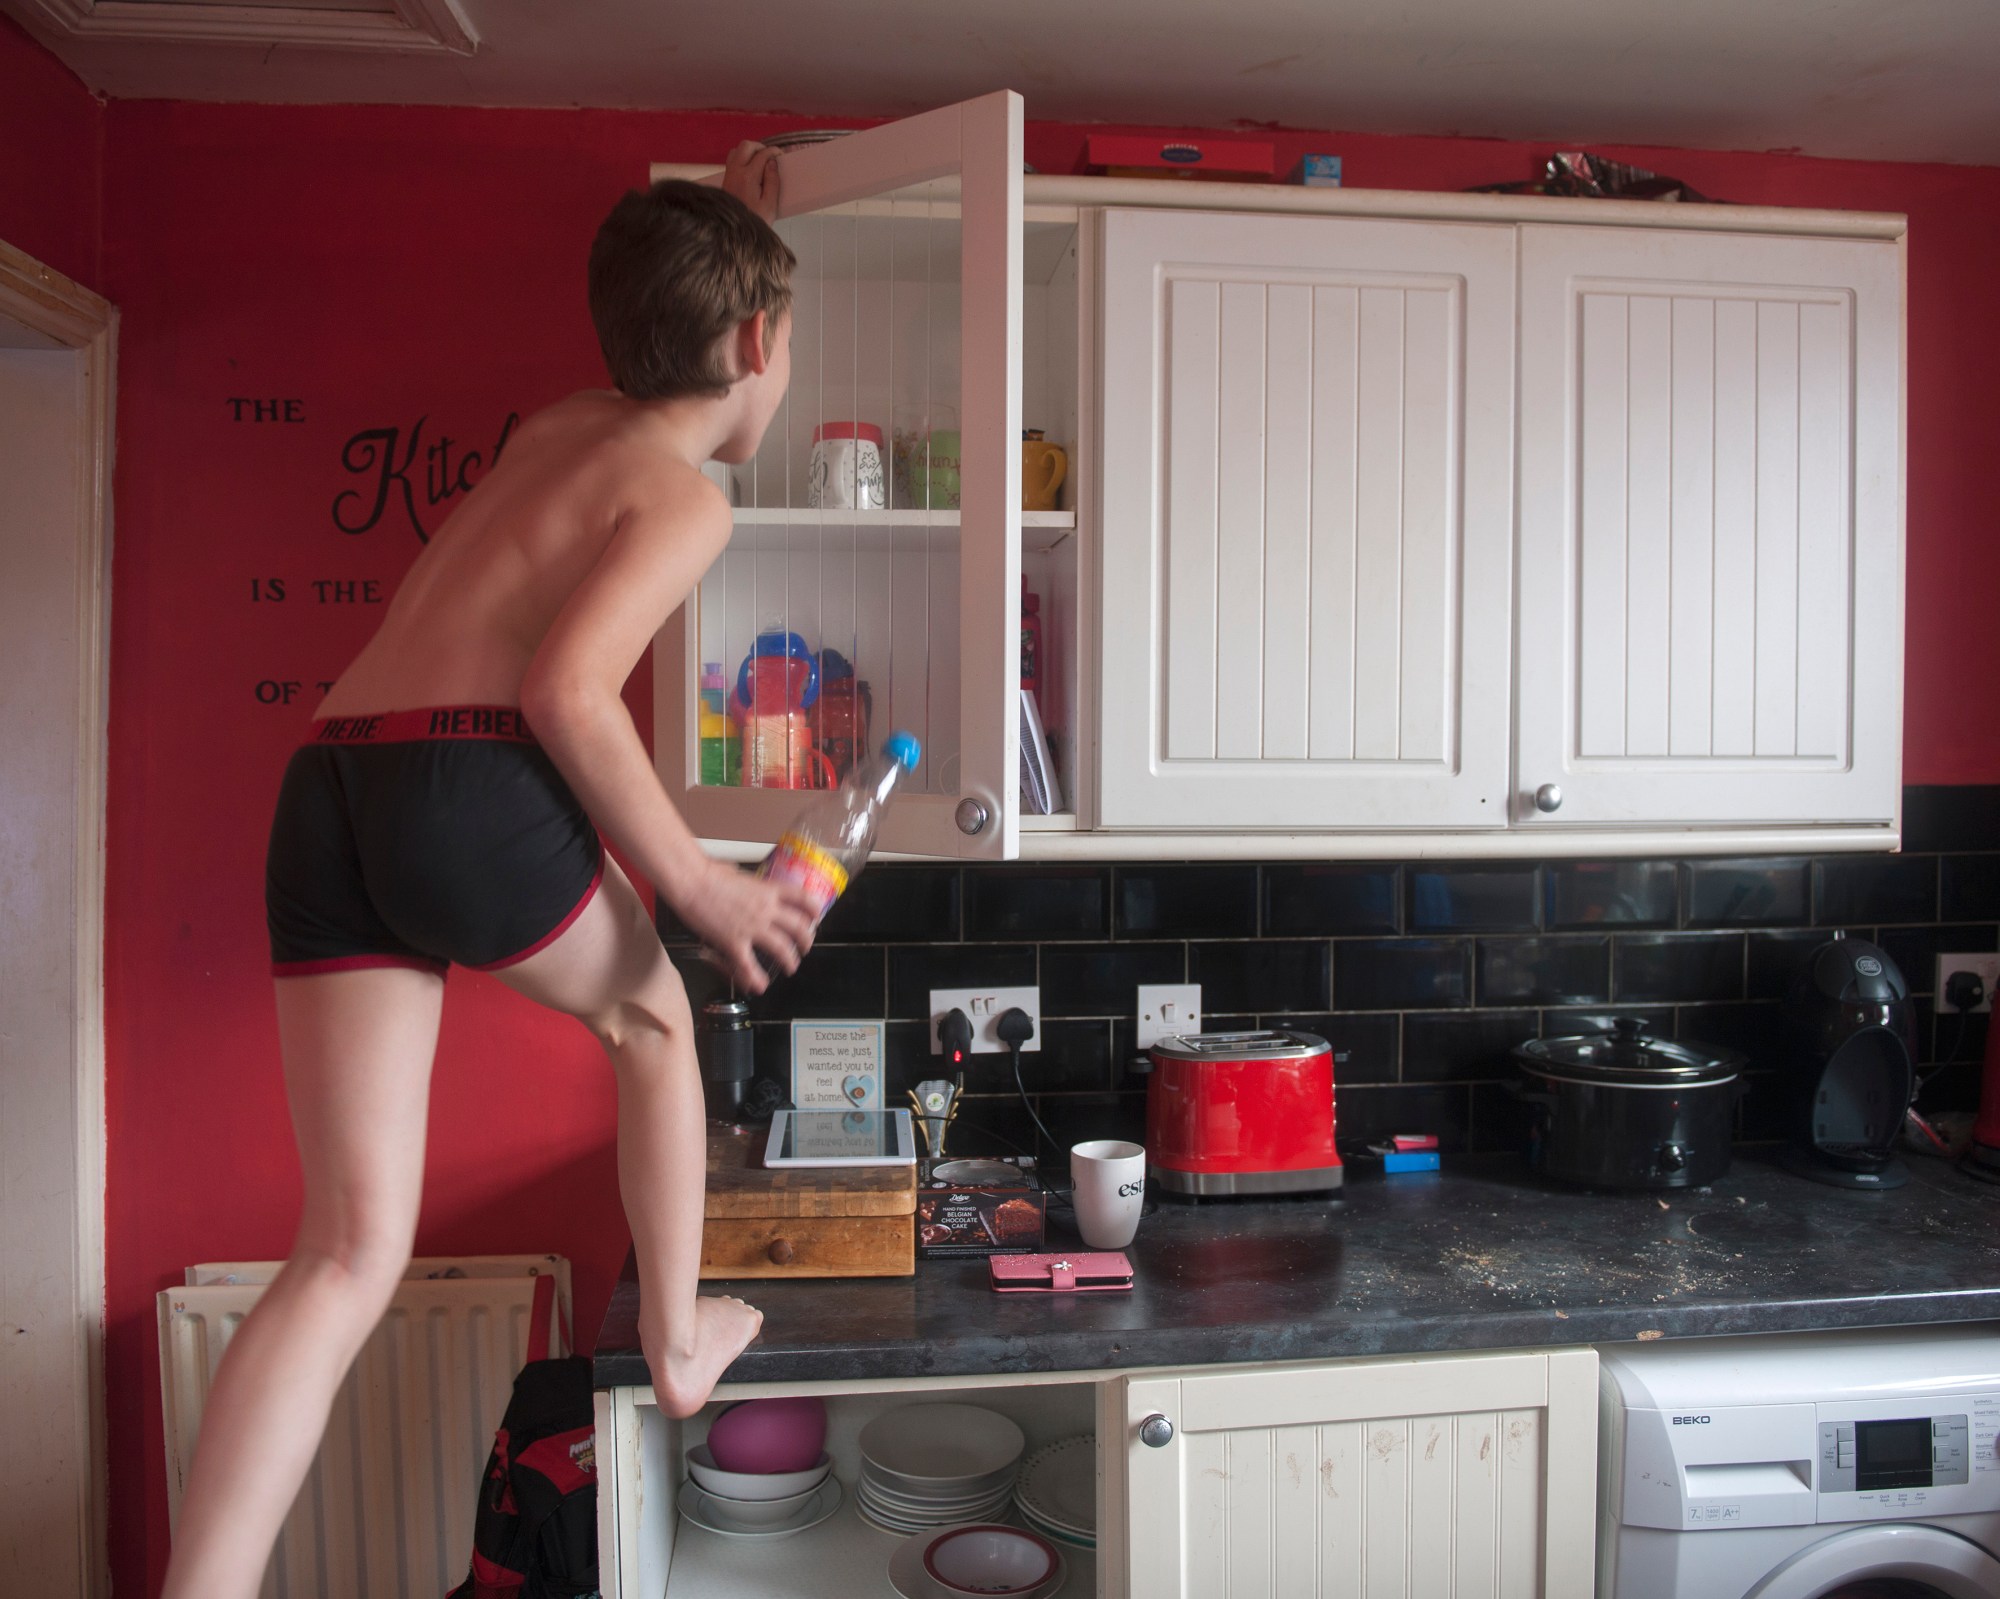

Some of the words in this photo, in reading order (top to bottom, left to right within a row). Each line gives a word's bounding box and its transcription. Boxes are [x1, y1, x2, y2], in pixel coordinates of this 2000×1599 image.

[226, 397, 306, 423] THE
[251, 578, 286, 602] IS
[312, 579, 383, 604] THE
[254, 679, 302, 704] OF
[315, 681, 336, 701] T
[316, 716, 384, 740] REBE
[815, 1031, 848, 1041] Excuse
[849, 1031, 867, 1041] the
[809, 1047, 835, 1056] mess,
[837, 1047, 850, 1056] we
[851, 1047, 872, 1057] just
[806, 1061, 842, 1071] wanted
[844, 1062, 861, 1072] you
[863, 1062, 875, 1071] to
[816, 1077, 833, 1087] feel
[804, 1093, 816, 1102] at
[1672, 1415, 1711, 1425] BEKO
